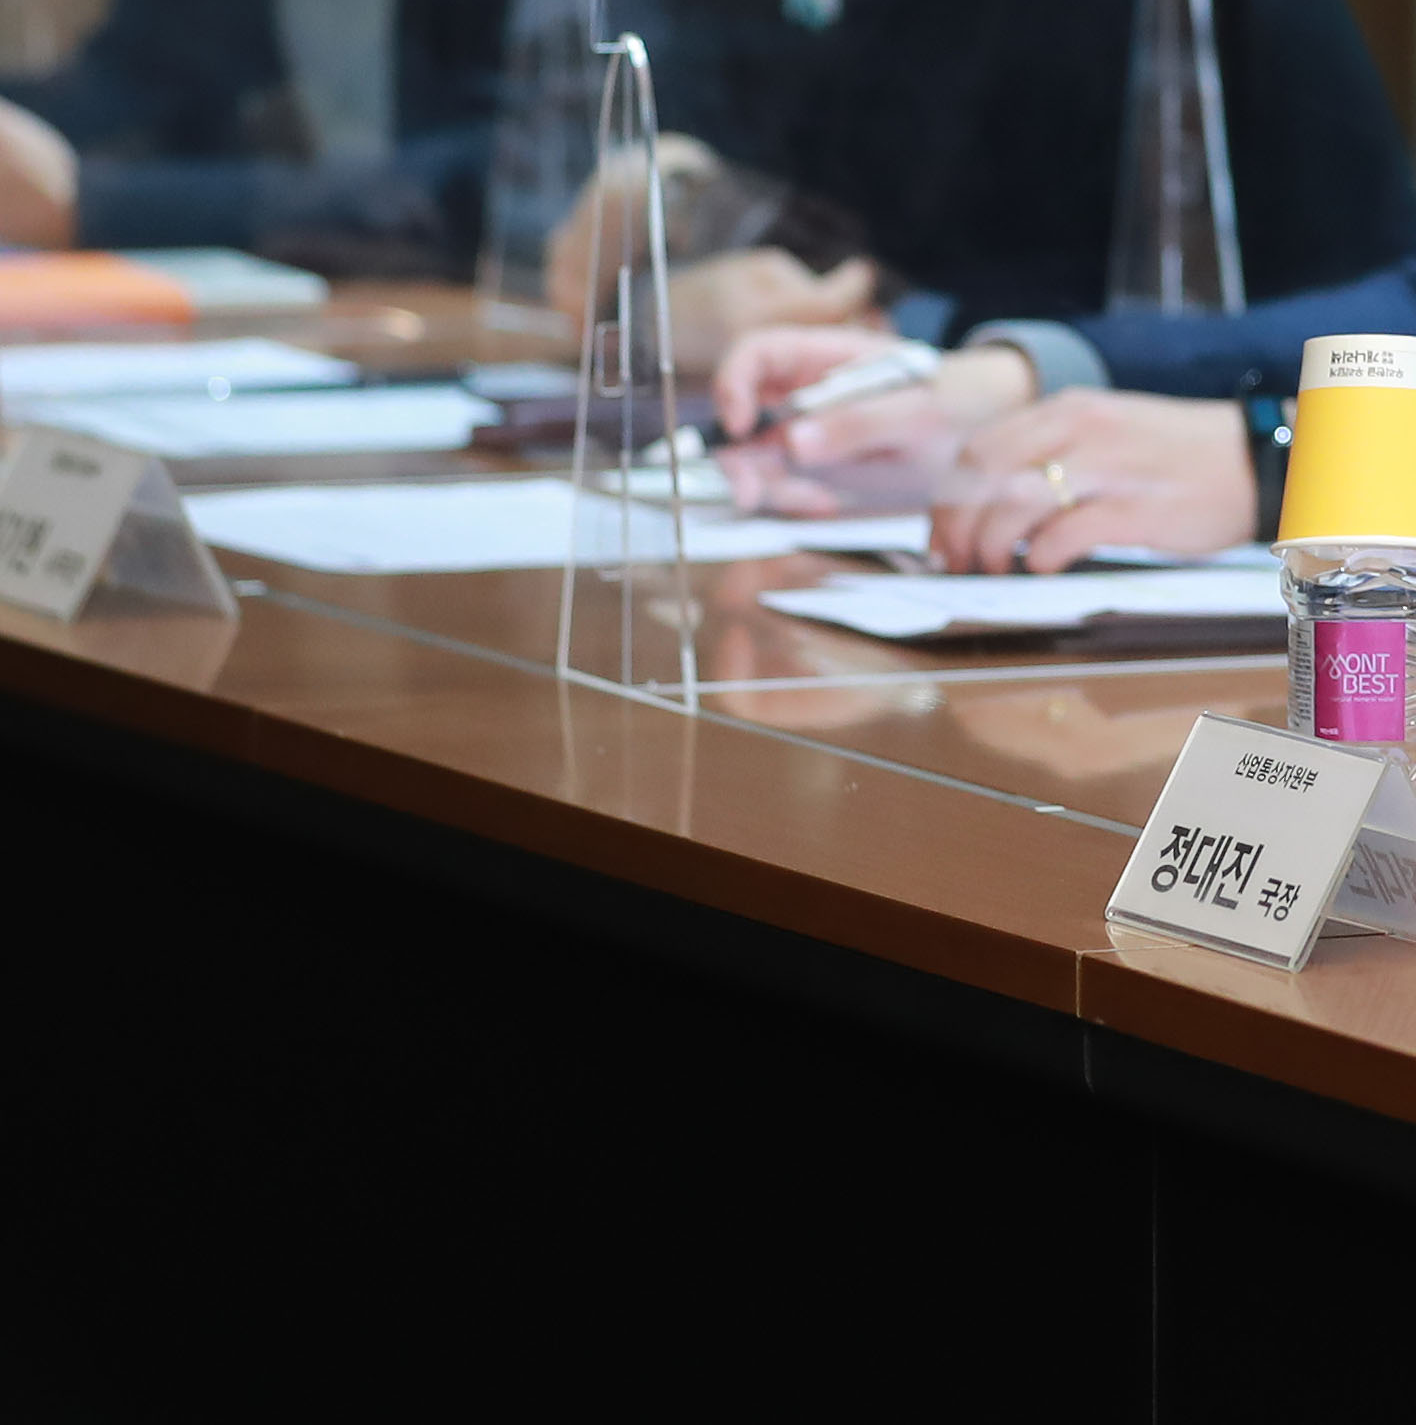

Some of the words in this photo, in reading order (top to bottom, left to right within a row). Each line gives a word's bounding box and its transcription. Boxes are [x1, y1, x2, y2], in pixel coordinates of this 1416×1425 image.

[1320, 652, 1391, 680] MONT
[1343, 674, 1399, 695] BEST
[1234, 752, 1320, 794] 산업통상자원부
[1151, 824, 1265, 911] 정대진
[1257, 877, 1302, 922] 국장
